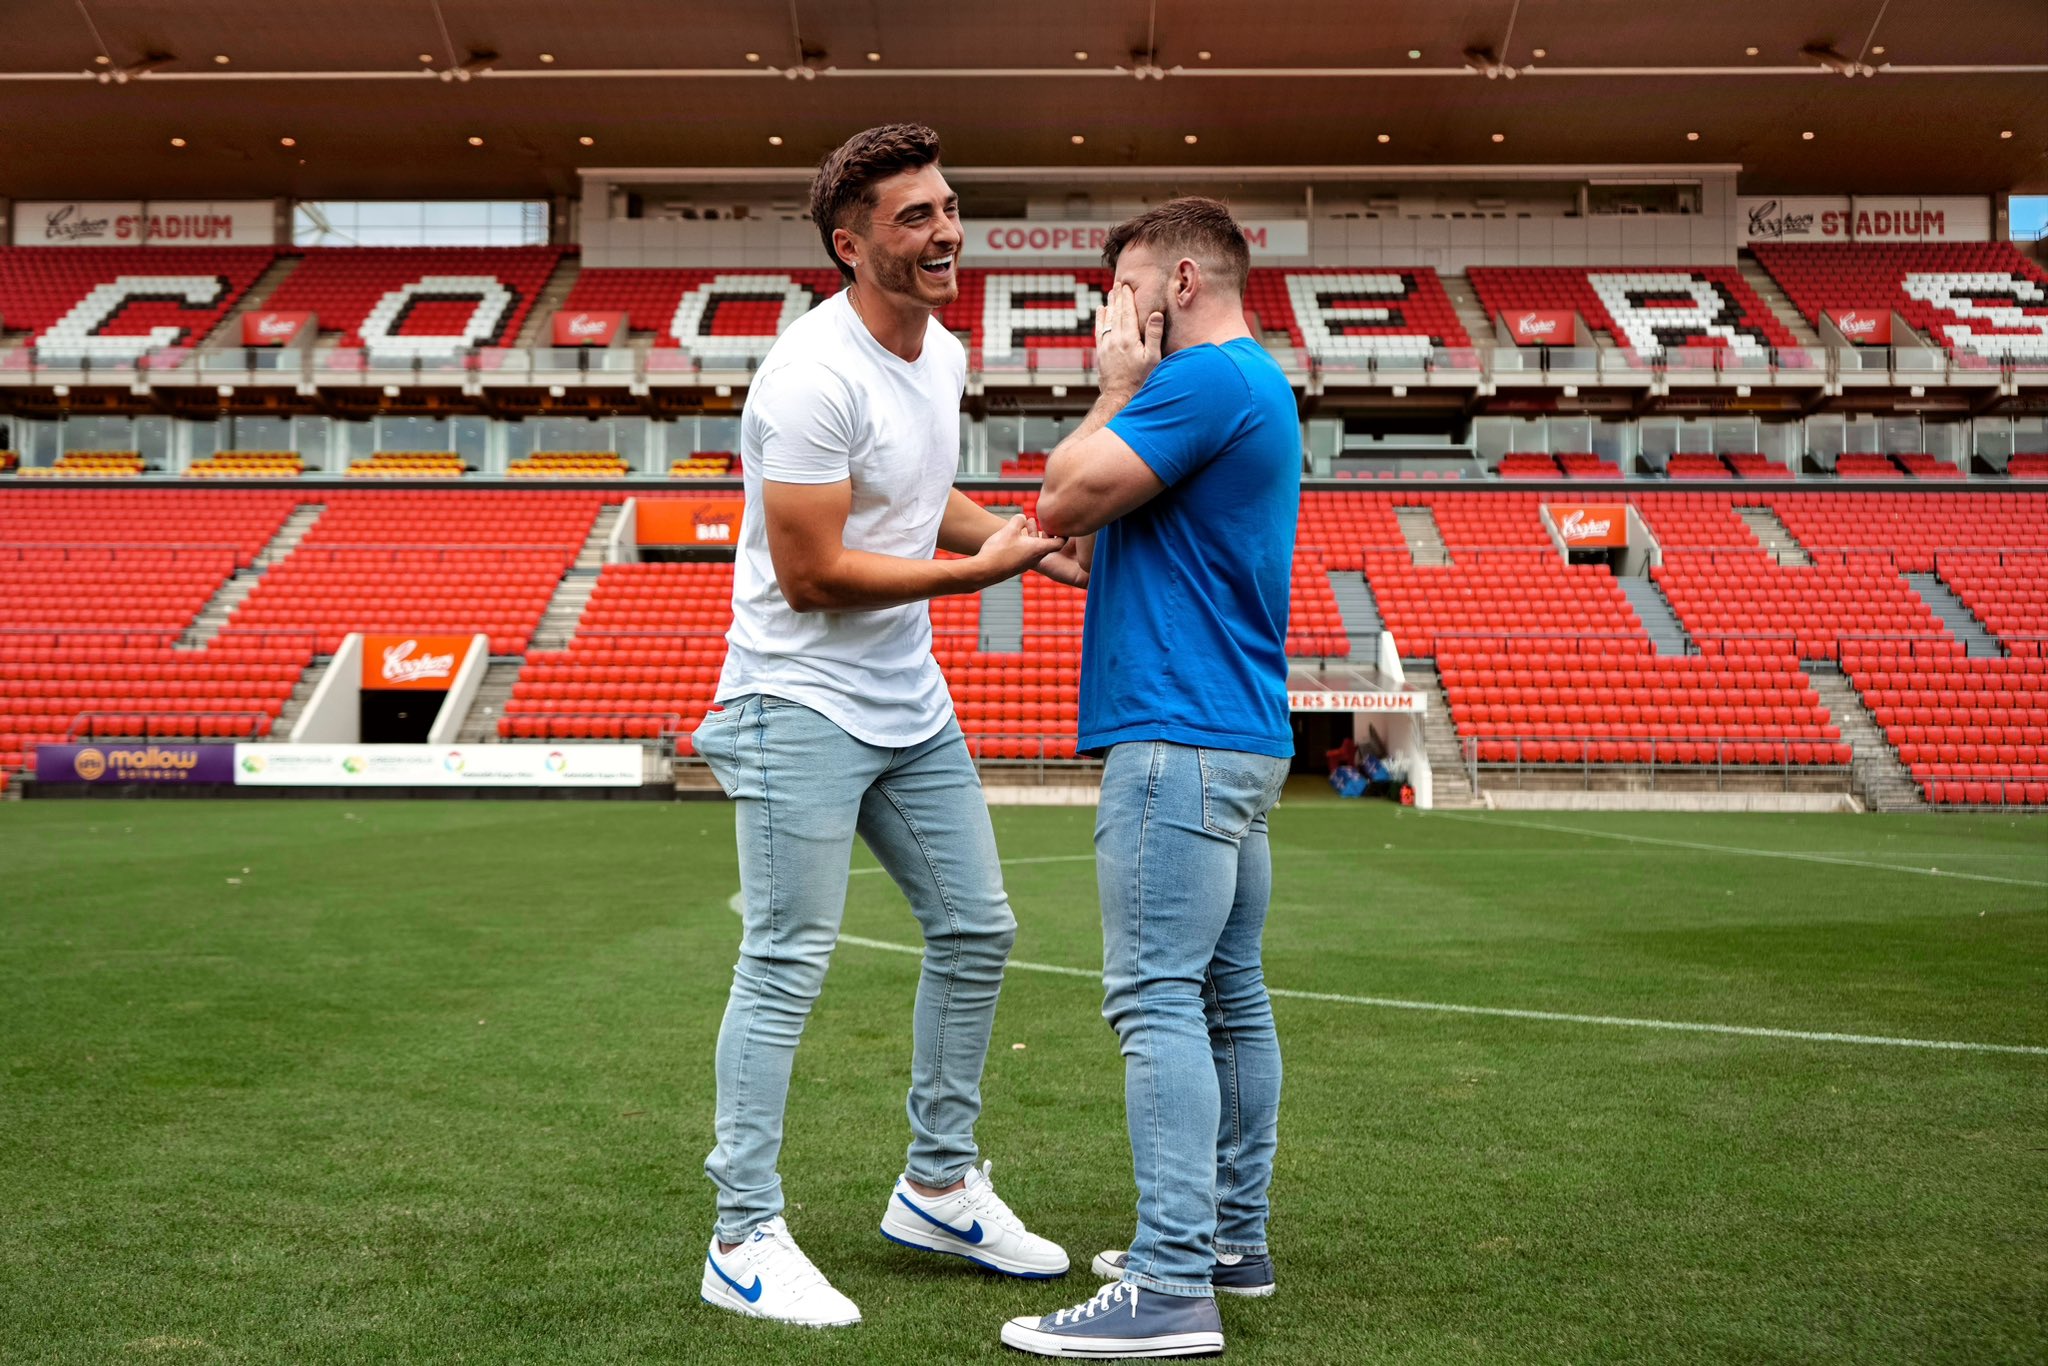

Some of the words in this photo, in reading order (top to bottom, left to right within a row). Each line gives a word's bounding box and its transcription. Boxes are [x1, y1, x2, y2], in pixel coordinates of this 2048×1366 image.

[115, 214, 232, 239] STADIUM
[1821, 210, 1945, 236] STADIUM
[987, 227, 1107, 250] COOPER
[696, 524, 730, 540] BAR
[1288, 696, 1326, 708] ERS
[1331, 695, 1413, 708] STADIUM
[108, 746, 198, 769] mallow
